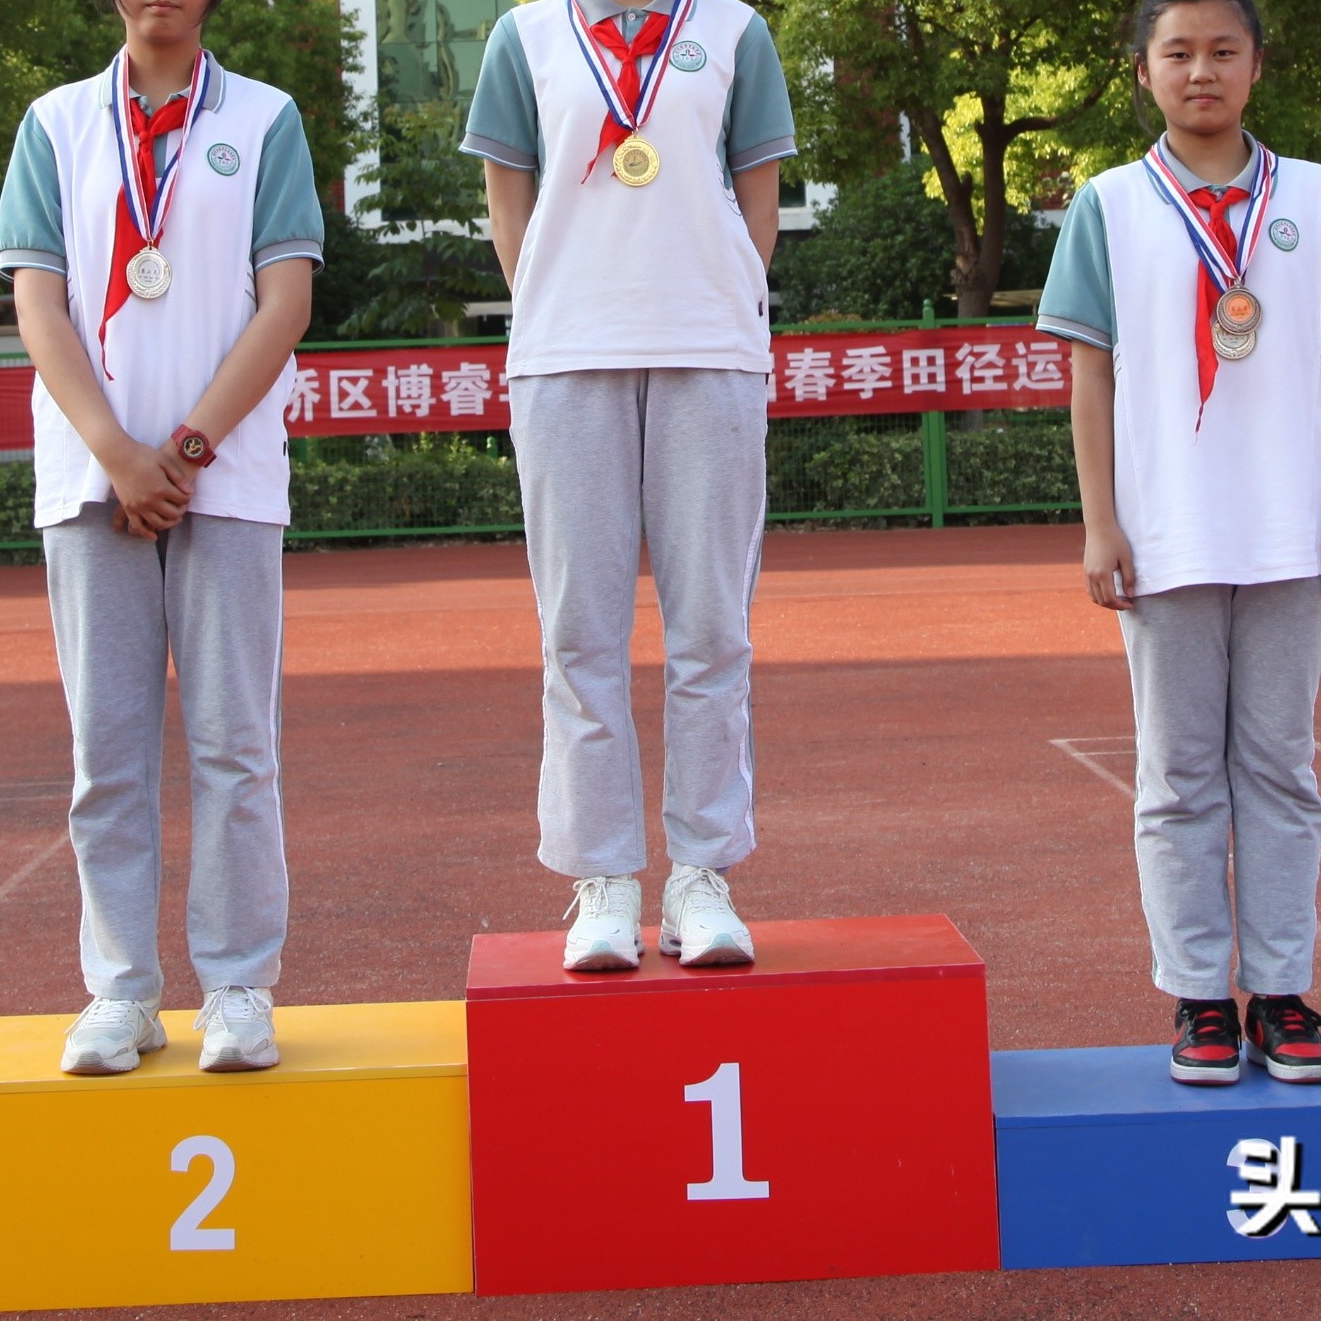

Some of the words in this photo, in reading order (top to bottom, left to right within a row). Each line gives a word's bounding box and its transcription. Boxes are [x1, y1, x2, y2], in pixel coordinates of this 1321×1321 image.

[287, 359, 509, 423] 桥区博睿
[770, 341, 1072, 403] 春季田径运
[684, 1062, 770, 1200] 1
[169, 1135, 236, 1251] 2
